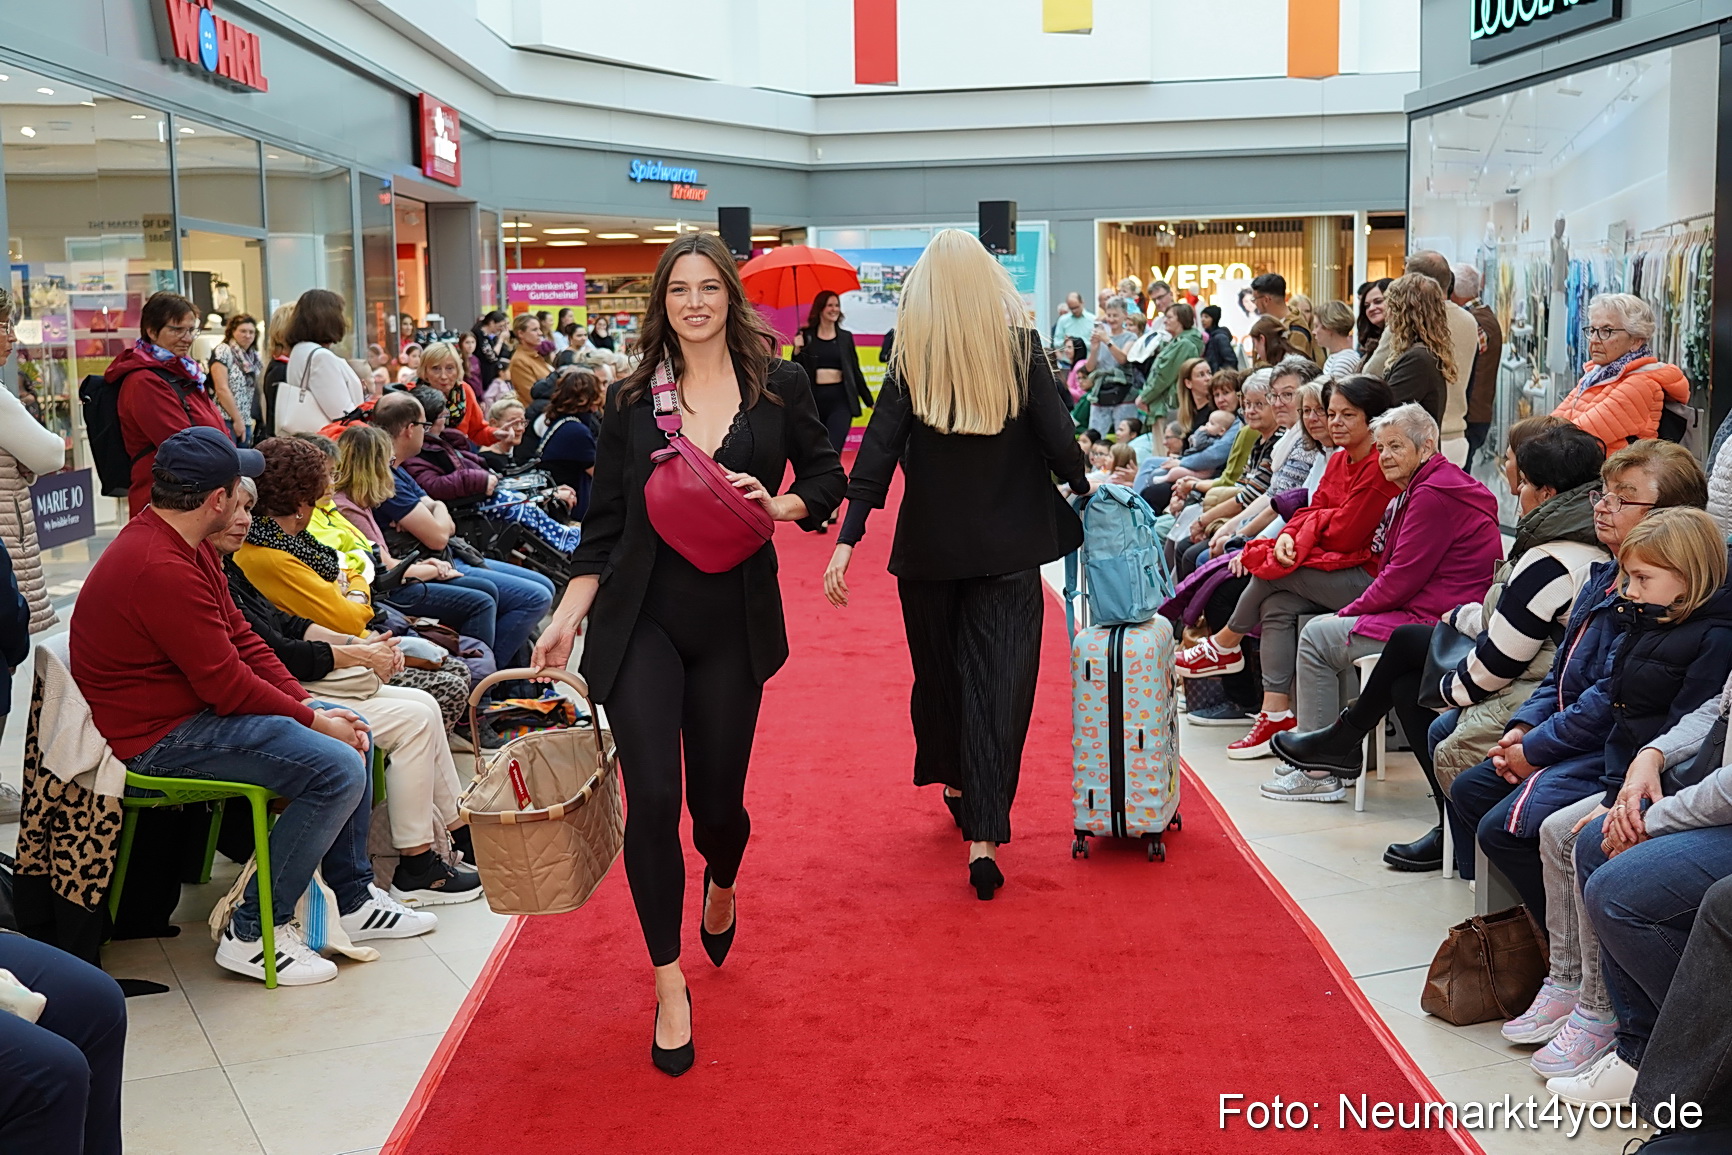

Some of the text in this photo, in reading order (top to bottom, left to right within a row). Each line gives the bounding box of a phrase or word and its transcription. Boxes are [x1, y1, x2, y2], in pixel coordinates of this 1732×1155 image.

[165, 0, 268, 93] WÖHRL
[629, 159, 698, 183] Spielwaren
[671, 183, 708, 201] Krömer
[511, 281, 579, 291] Verschenken Sie
[1151, 262, 1252, 289] VERO
[528, 291, 579, 301] Gutscheine!
[36, 485, 84, 516] MARIE JO
[43, 521, 51, 532] My
